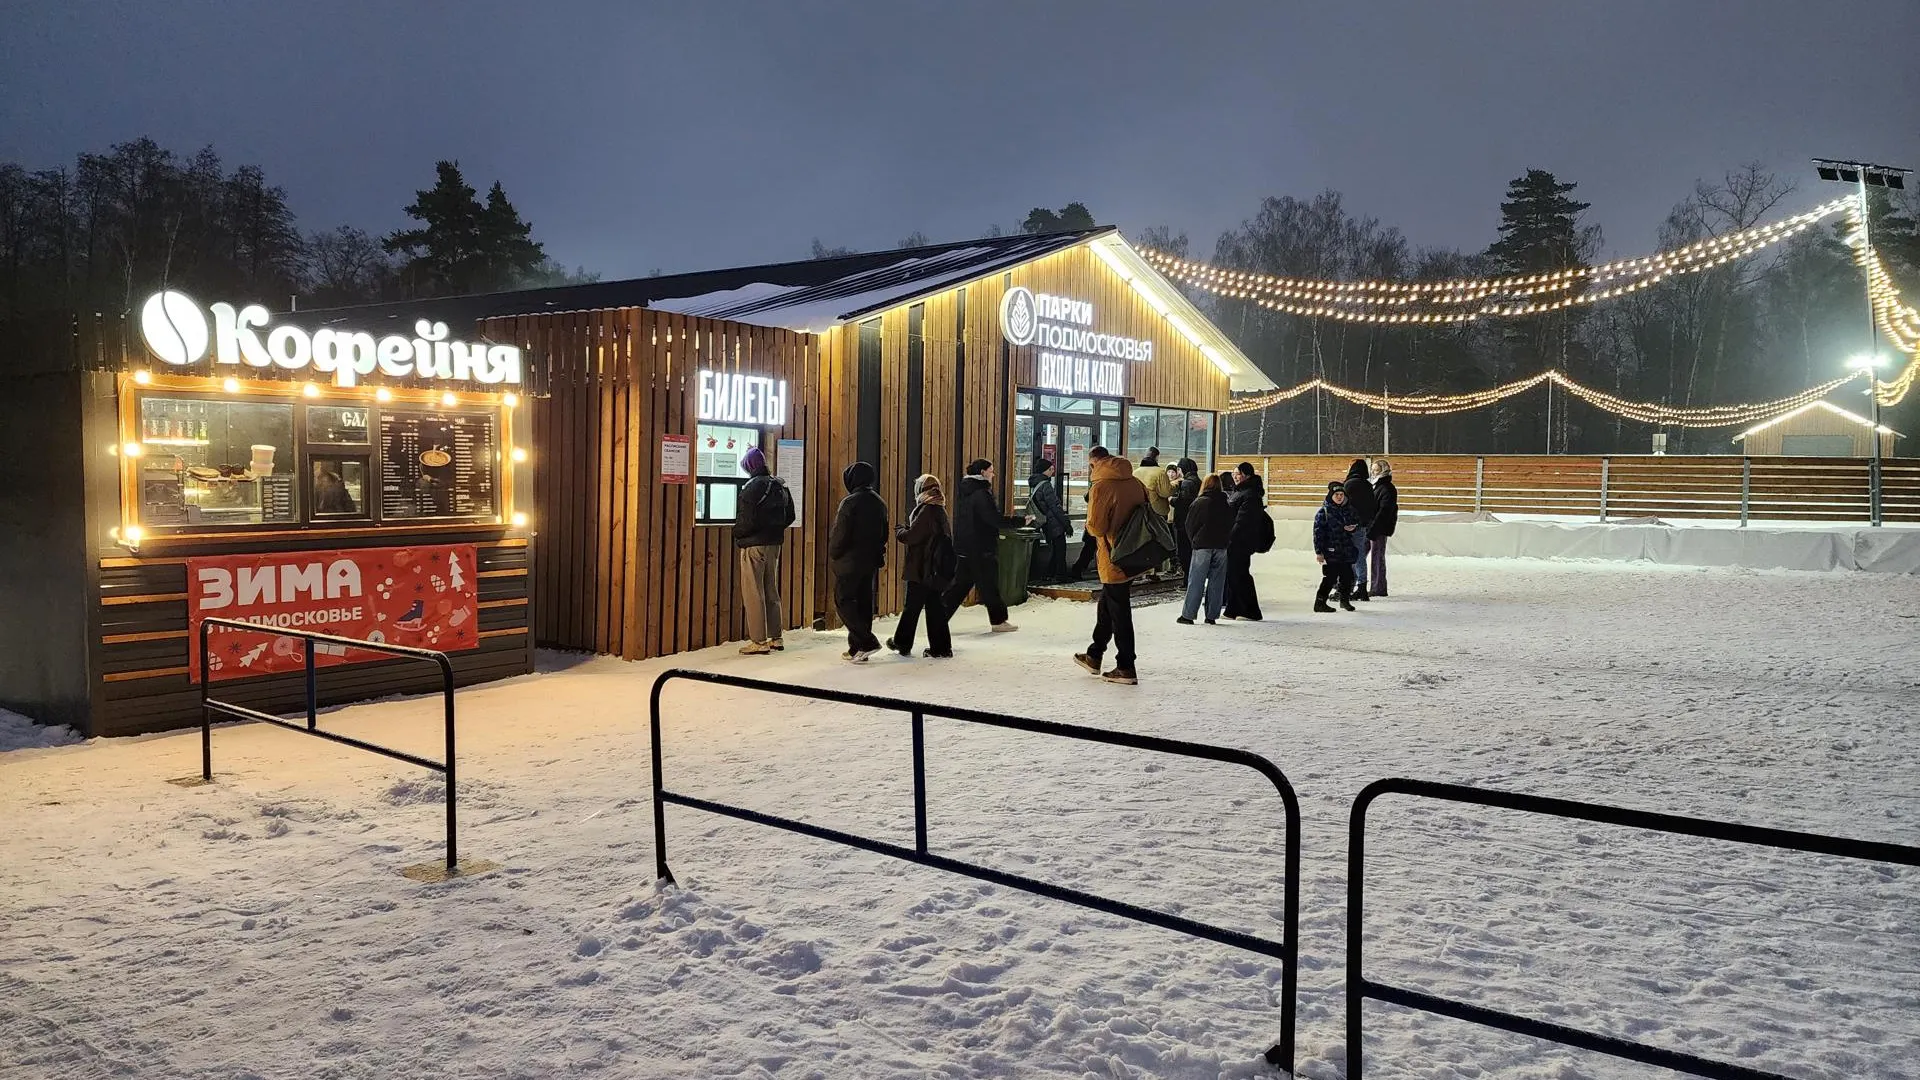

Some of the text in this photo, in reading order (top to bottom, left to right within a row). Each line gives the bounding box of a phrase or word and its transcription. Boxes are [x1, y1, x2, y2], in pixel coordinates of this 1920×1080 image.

[1036, 294, 1093, 325] ПАРКИ
[210, 301, 521, 387] Кофейня
[1037, 322, 1153, 362] ПОДМОСКОВЬЯ
[697, 369, 787, 426] БИЛЕТЫ
[1038, 352, 1124, 396] ВХОД НА КАТОК
[198, 558, 363, 610] ЗИМА
